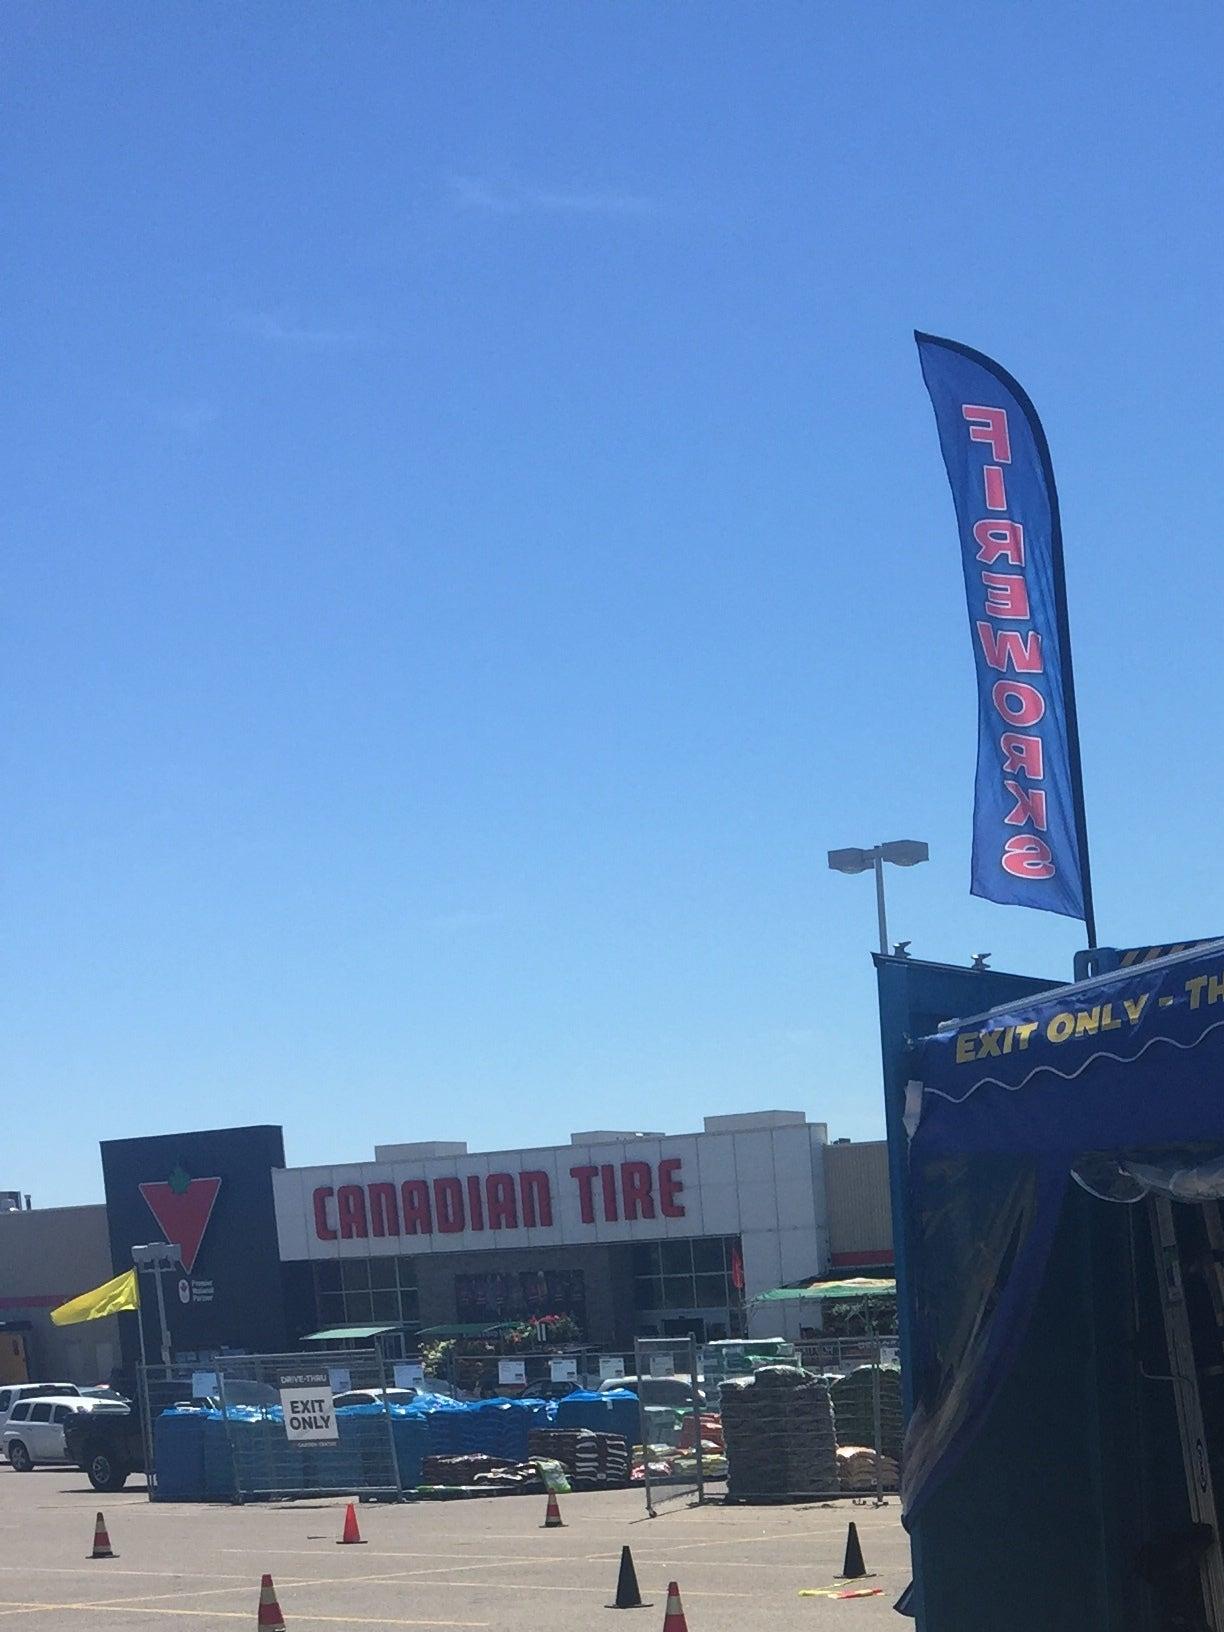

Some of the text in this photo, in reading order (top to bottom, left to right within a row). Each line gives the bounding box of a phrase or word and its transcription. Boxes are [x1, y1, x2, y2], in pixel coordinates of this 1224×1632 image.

[955, 1022, 1039, 1064] EXIT
[1046, 992, 1150, 1045] ONLY
[312, 1157, 687, 1242] CANADIAN TIRE
[280, 1374, 328, 1384] DRIVE-THRU
[289, 1399, 325, 1415] EXIT
[289, 1415, 331, 1431] ONLY
